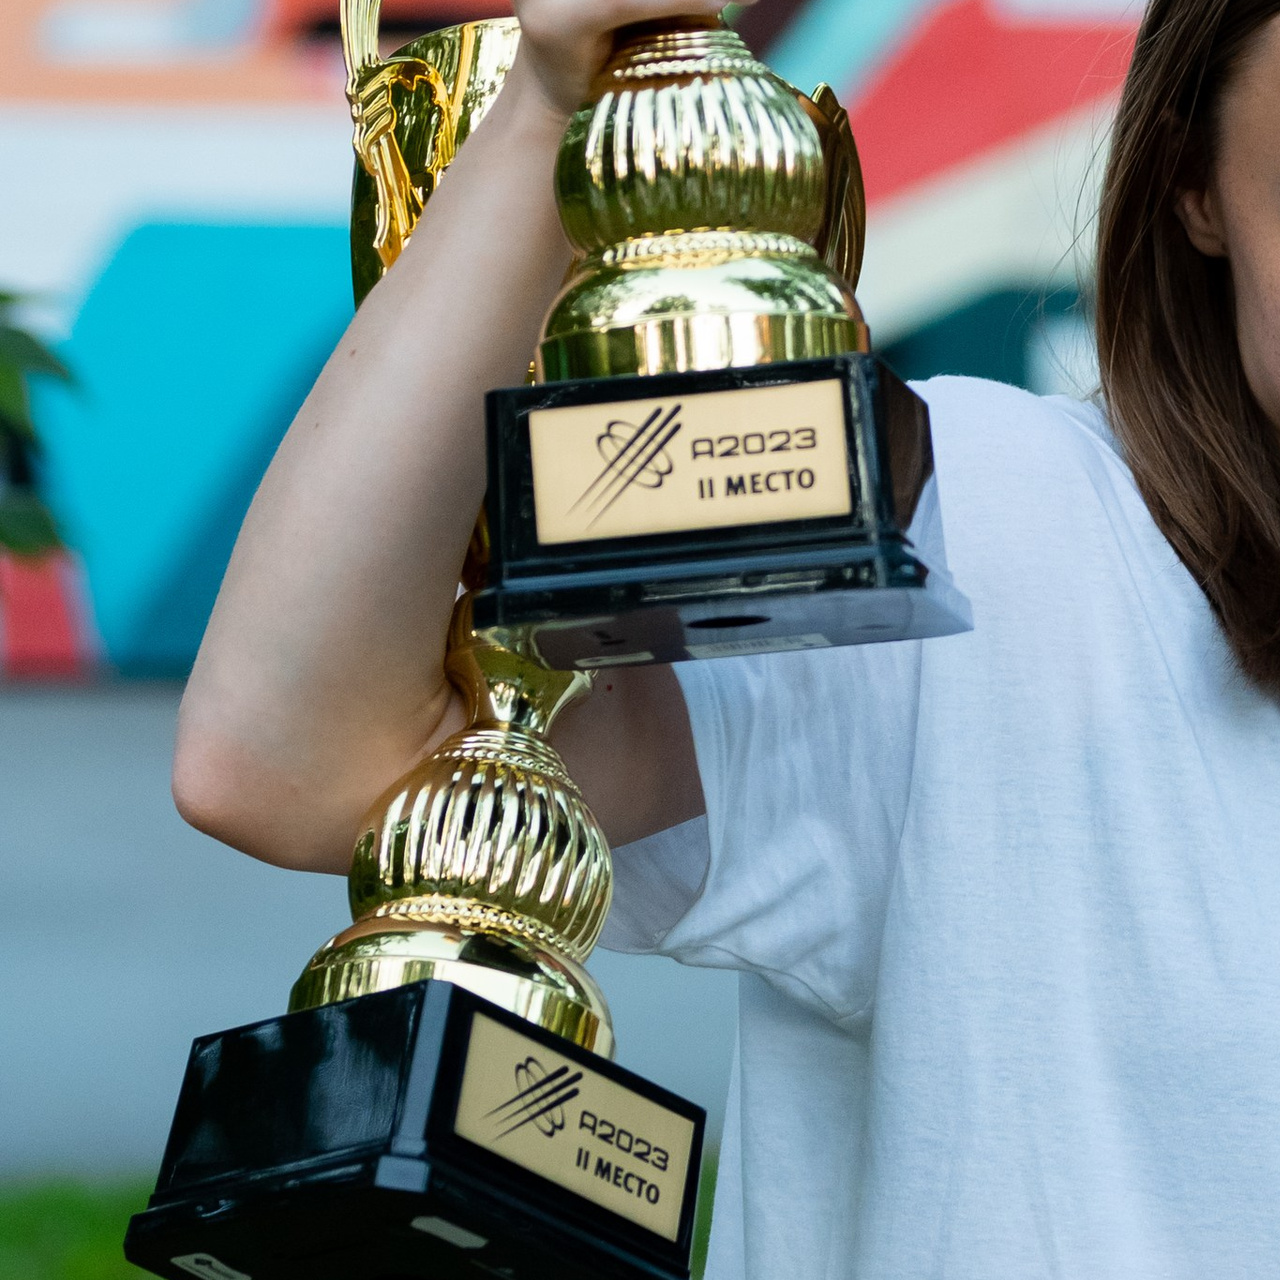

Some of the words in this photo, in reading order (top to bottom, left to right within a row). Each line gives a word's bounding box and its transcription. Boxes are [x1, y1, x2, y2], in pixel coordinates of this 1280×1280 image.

[692, 426, 817, 460] A2023
[725, 467, 815, 497] МЕСТО
[578, 1109, 669, 1172] A2023
[594, 1156, 660, 1205] МЕСТО
